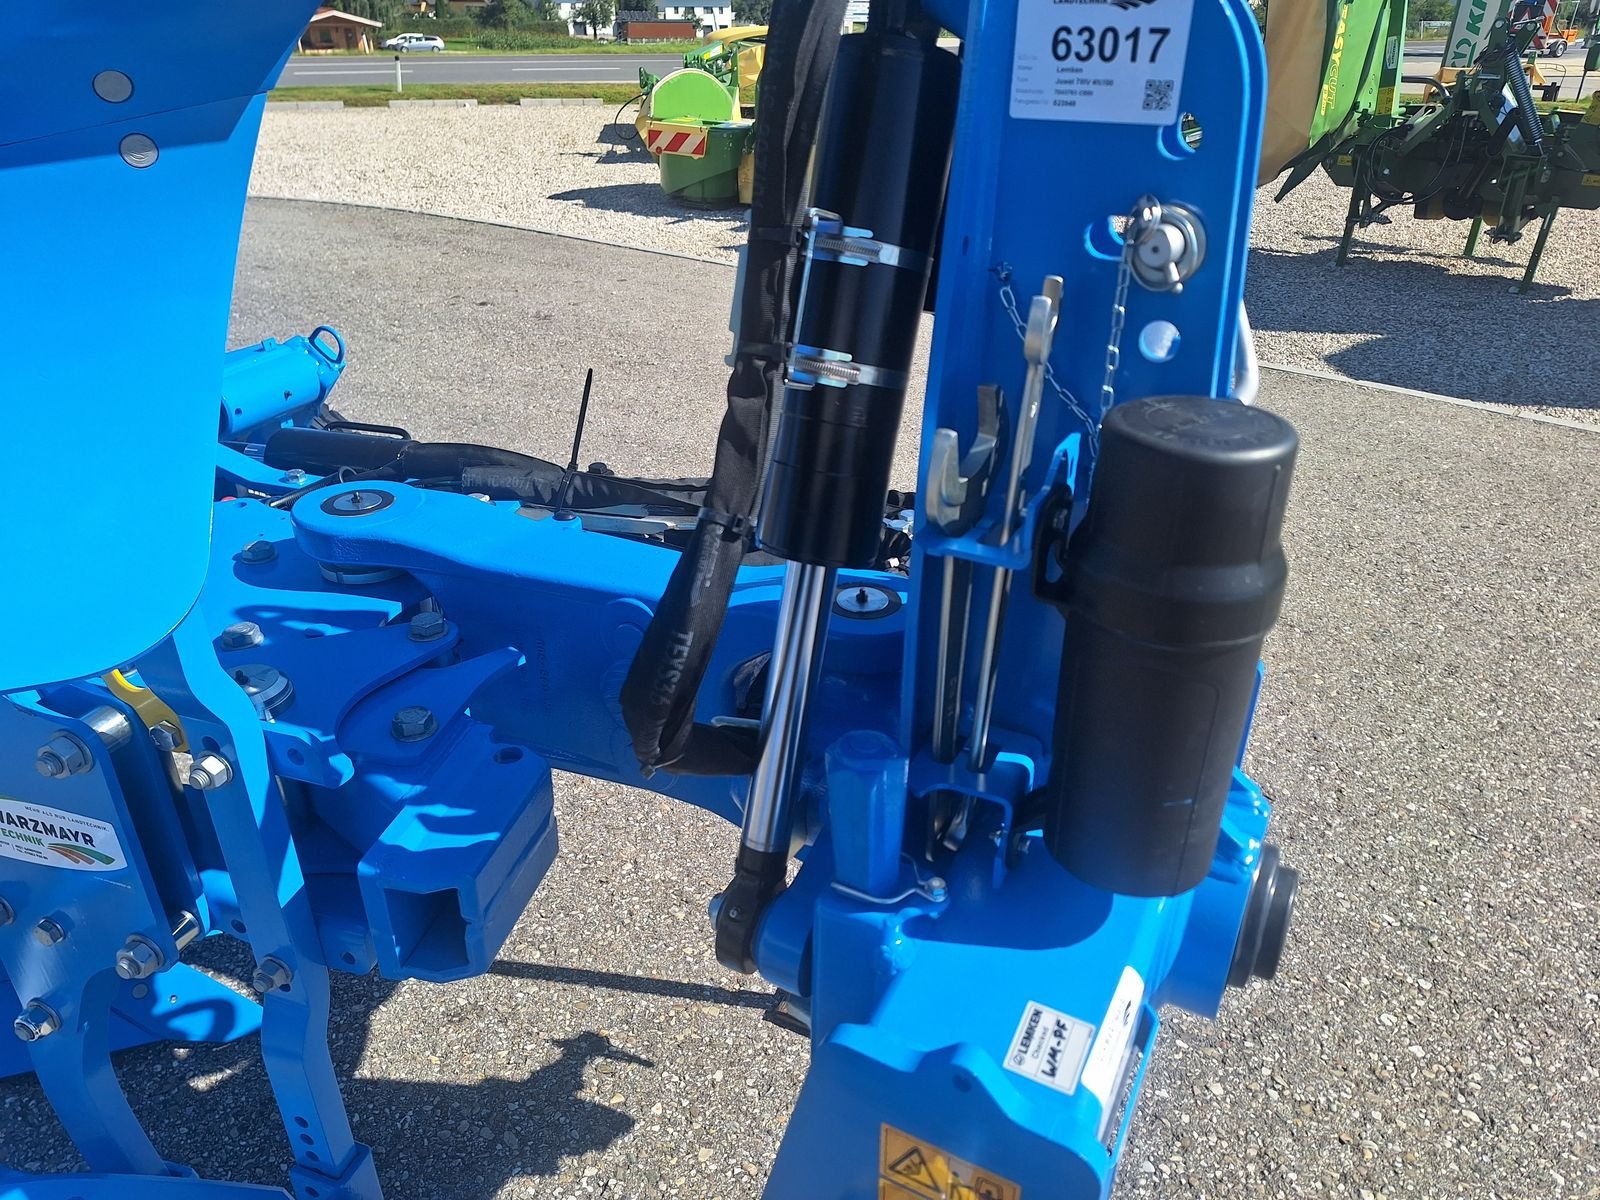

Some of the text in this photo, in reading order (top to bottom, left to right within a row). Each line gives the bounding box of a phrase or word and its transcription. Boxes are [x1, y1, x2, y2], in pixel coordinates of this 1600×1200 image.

[1051, 25, 1171, 64] 63017
[0, 828, 45, 847] ECHNIK
[1018, 1008, 1043, 1055] LEMKEN
